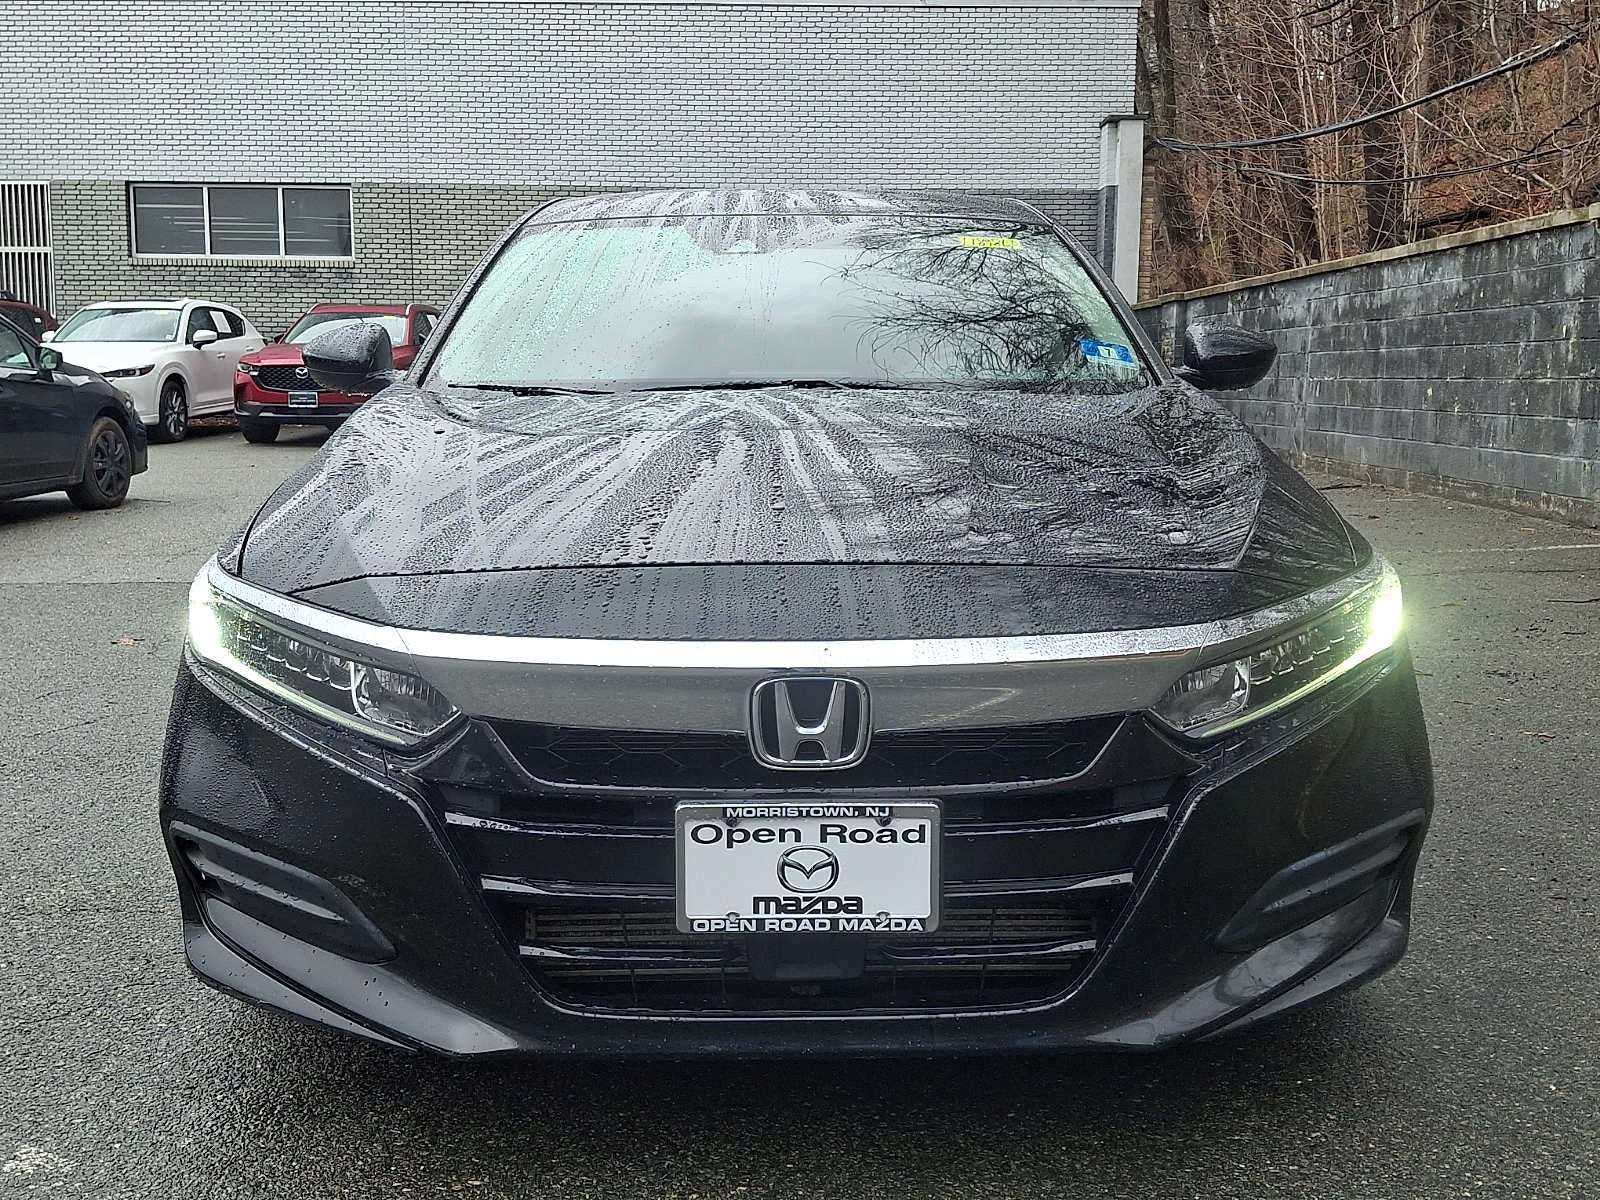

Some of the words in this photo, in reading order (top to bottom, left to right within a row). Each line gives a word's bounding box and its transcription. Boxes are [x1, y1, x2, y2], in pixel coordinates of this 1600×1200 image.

[727, 807, 858, 818] MORRISTOWN,
[864, 807, 890, 817] NJ
[691, 823, 802, 848] Open
[820, 823, 926, 844] Road
[692, 918, 756, 932] OPEN
[764, 918, 831, 932] ROAD
[838, 918, 924, 932] MAZDA
